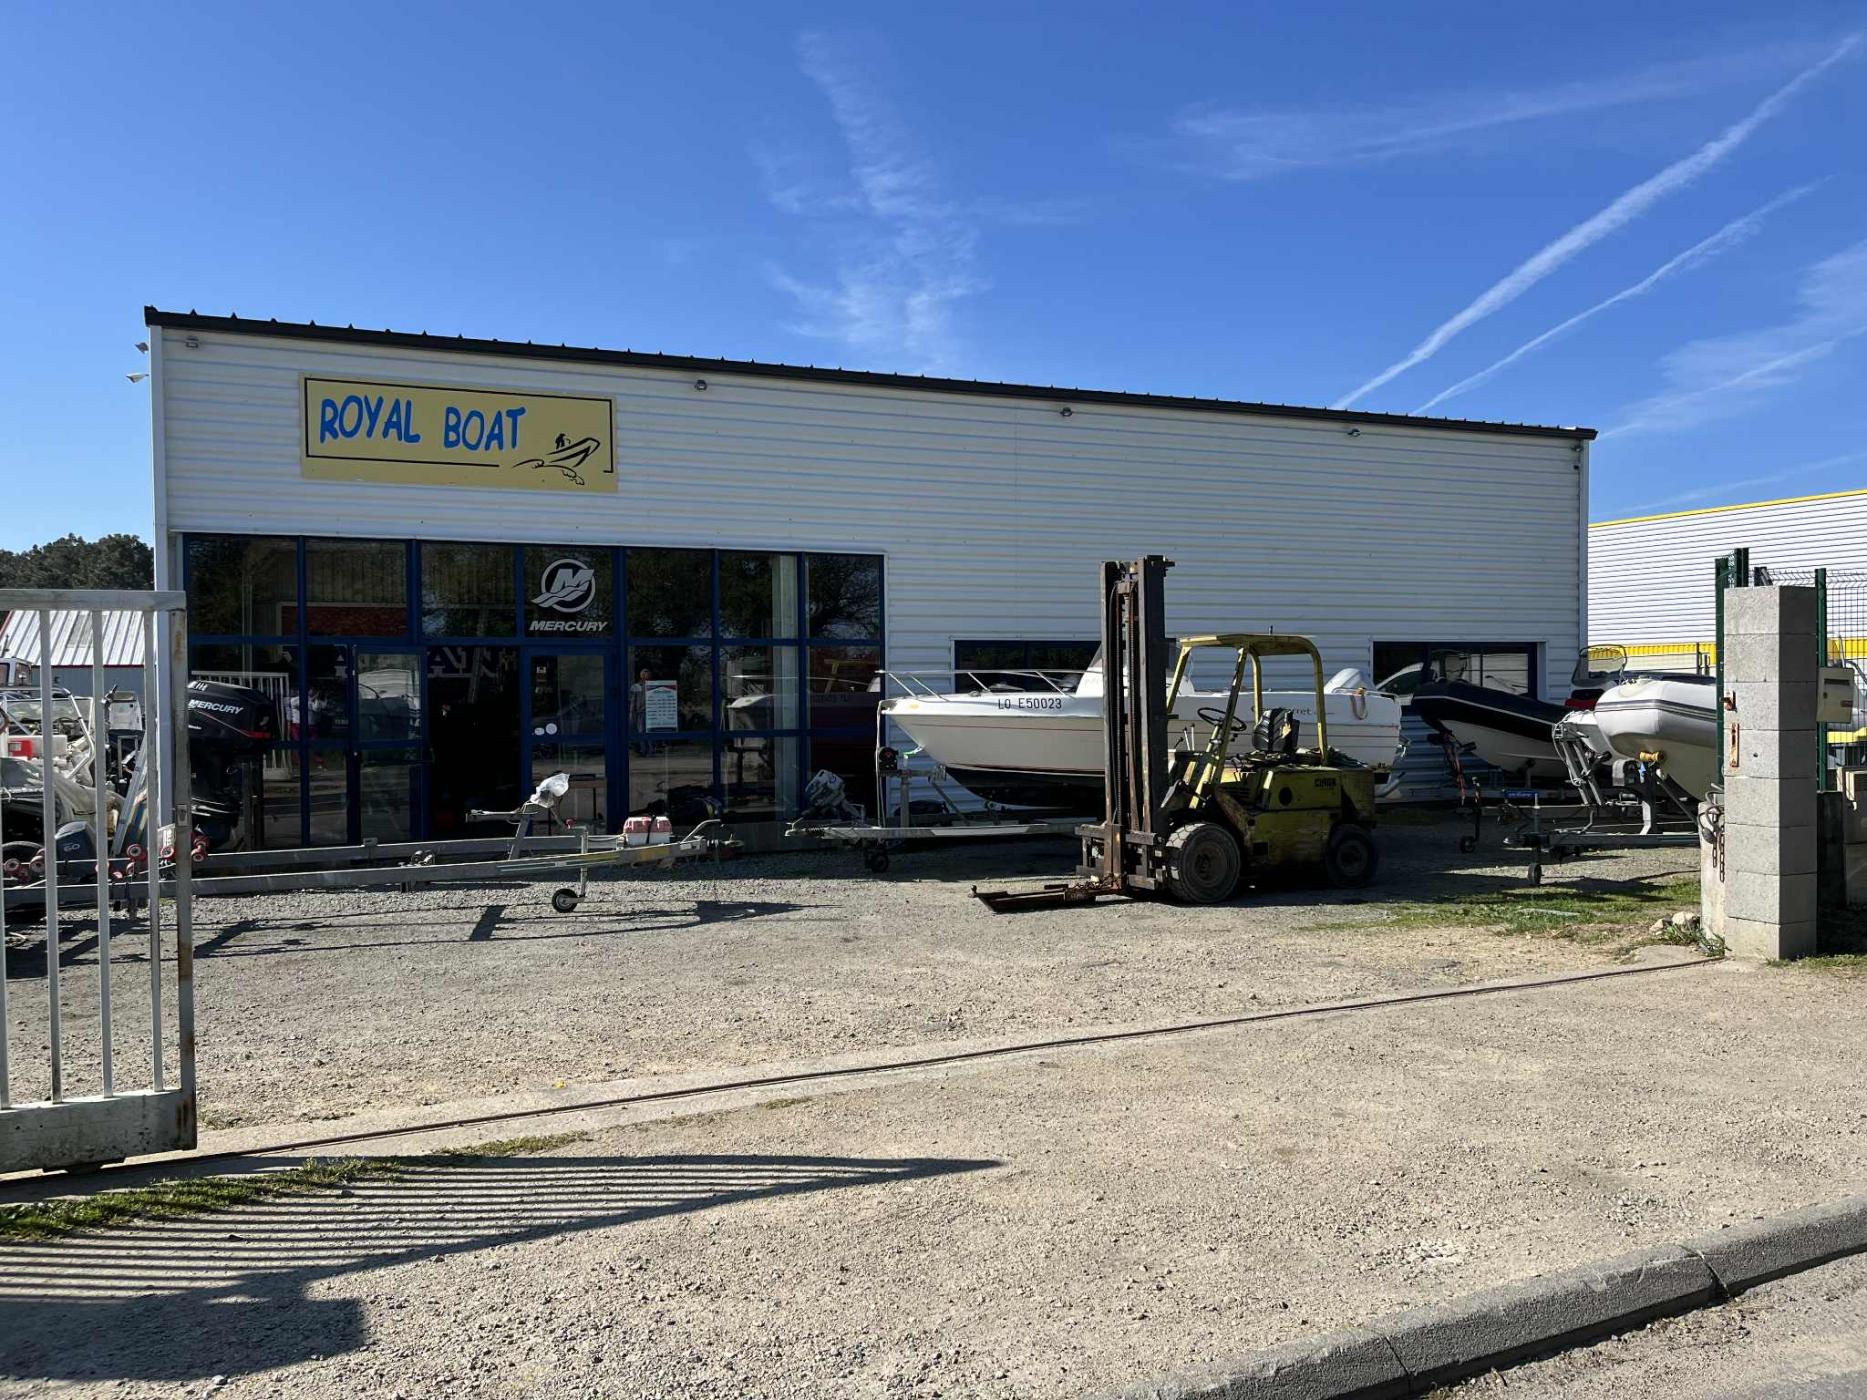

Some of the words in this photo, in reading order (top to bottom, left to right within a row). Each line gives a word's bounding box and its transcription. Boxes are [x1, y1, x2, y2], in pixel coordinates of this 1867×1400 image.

[320, 395, 421, 444] ROYAL
[443, 405, 526, 451] BOAT
[529, 620, 608, 632] MERCURY
[187, 699, 244, 715] MERCURY
[1018, 697, 1062, 710] E50023
